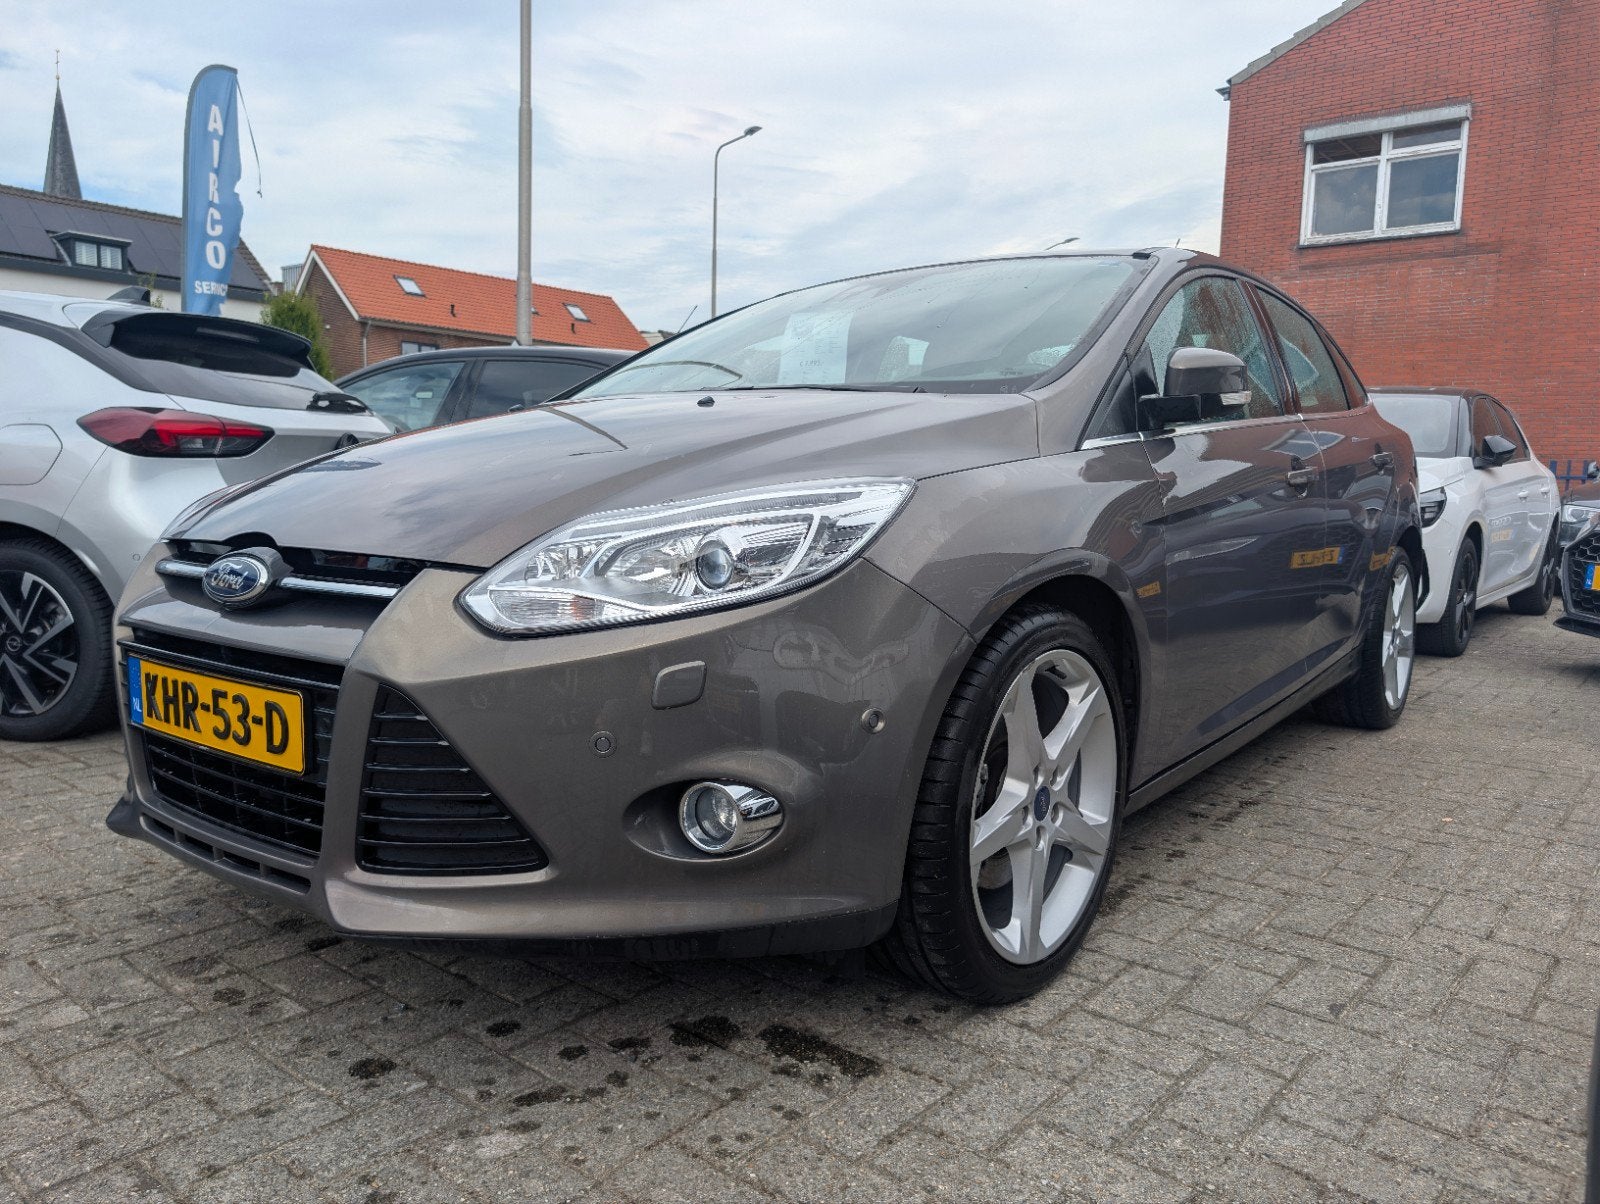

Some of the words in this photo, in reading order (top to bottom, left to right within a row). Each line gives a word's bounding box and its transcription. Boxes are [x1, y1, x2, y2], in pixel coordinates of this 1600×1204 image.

[205, 104, 227, 270] AIRCO
[210, 562, 249, 590] Ford
[132, 697, 142, 713] NL
[144, 672, 290, 756] KHR-53-D
